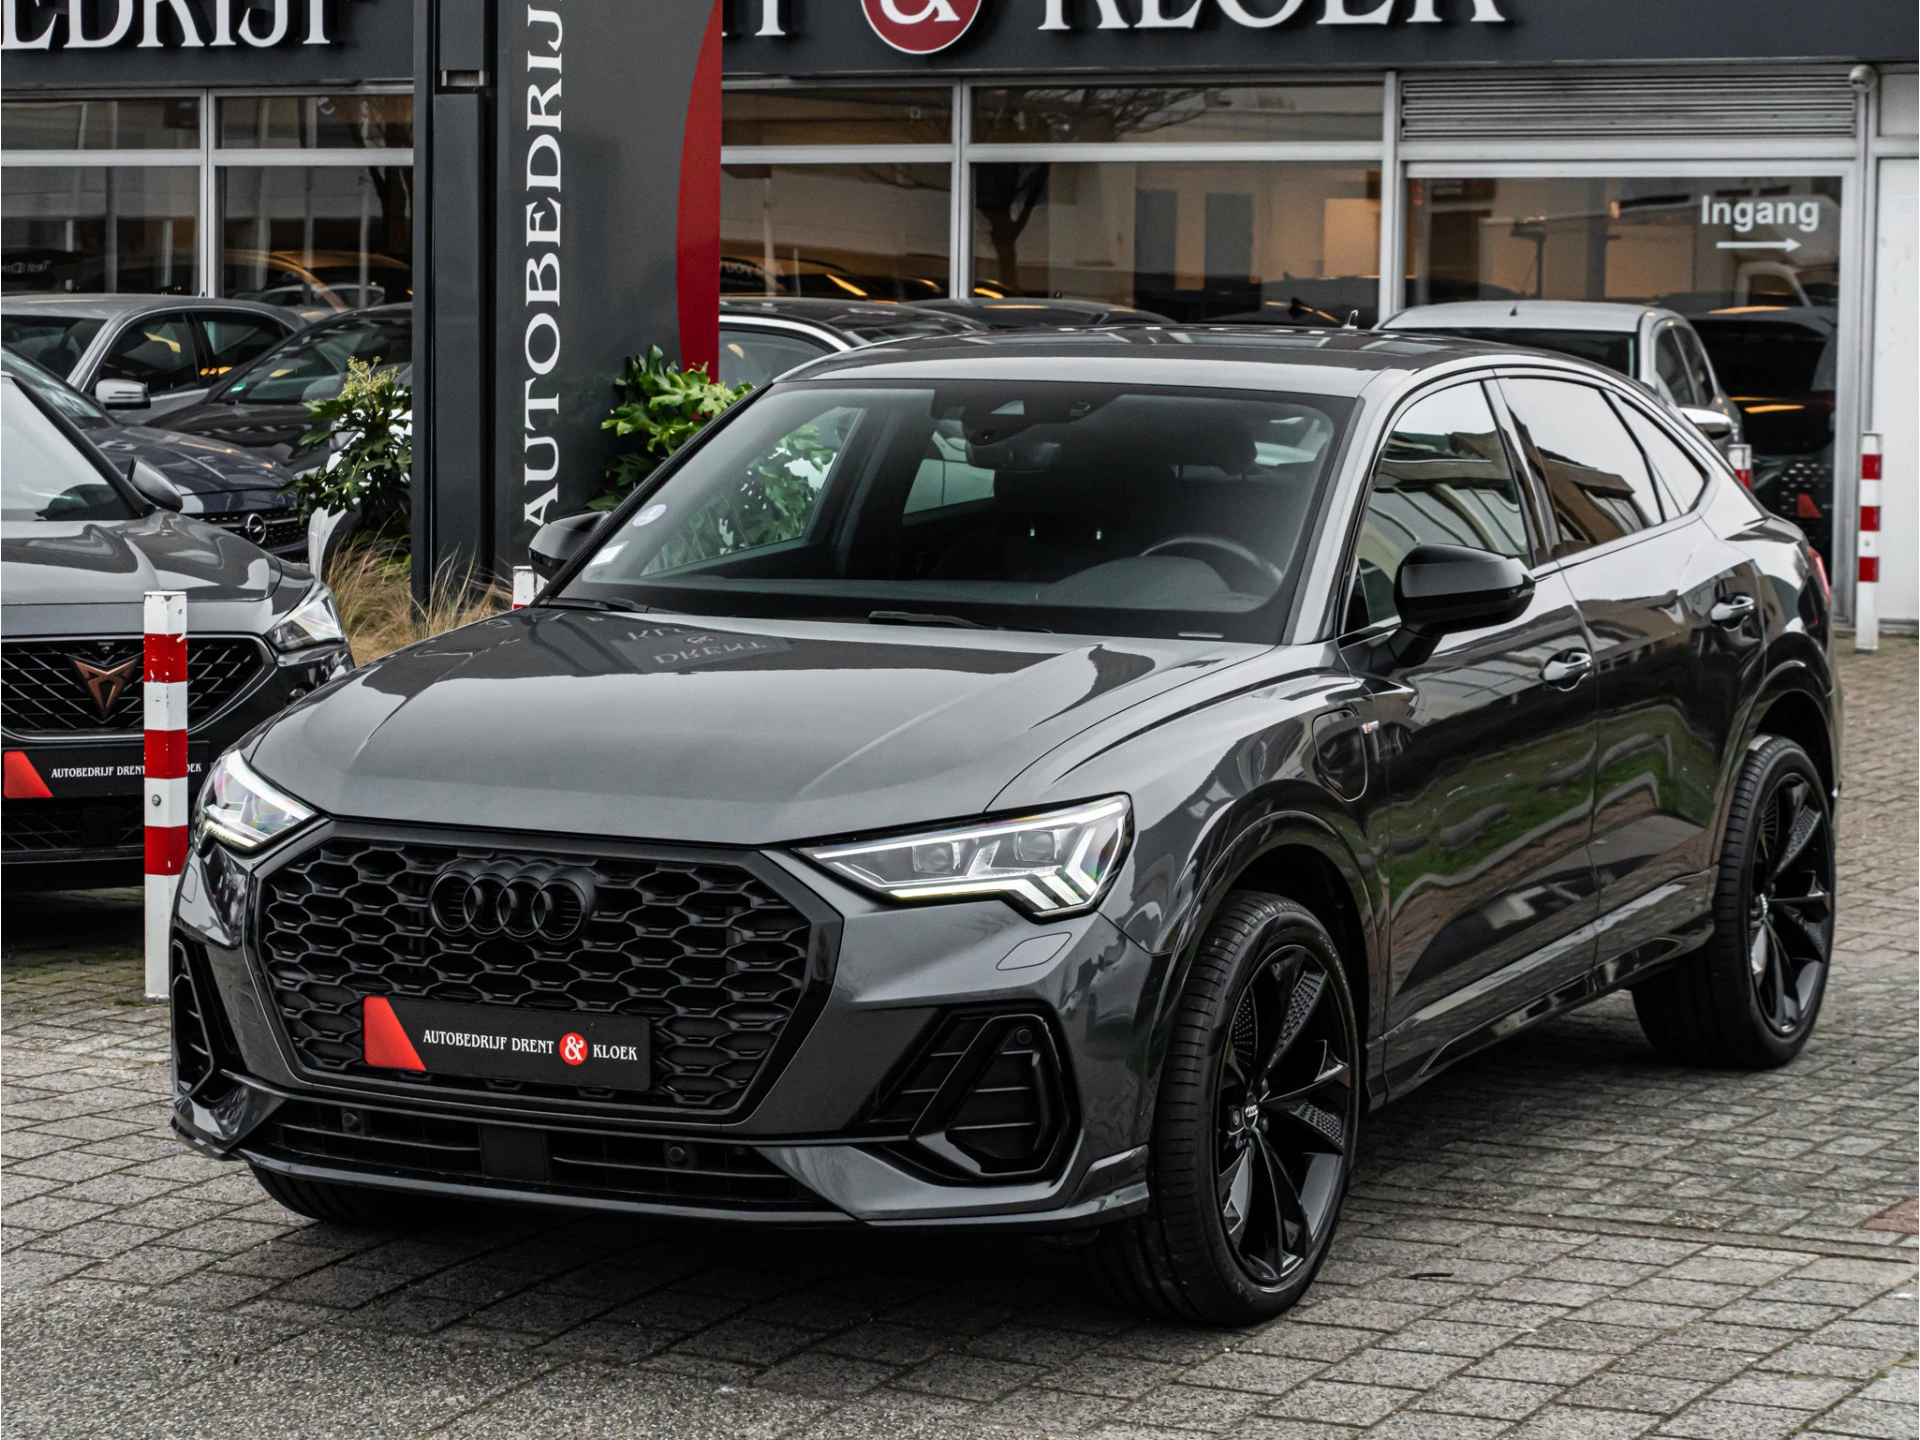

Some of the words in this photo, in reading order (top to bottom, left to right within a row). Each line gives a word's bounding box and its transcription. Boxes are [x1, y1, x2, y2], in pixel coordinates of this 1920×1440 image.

[1701, 195, 1820, 232] Ingang
[524, 4, 563, 527] AUTOBEDRIJ
[51, 766, 115, 778] AUTOBEDRIJF
[423, 1029, 507, 1050] AUTOBEDRIJF
[511, 1038, 554, 1054] DRENT
[564, 1036, 584, 1060] &
[593, 1044, 638, 1060] KLOEK
